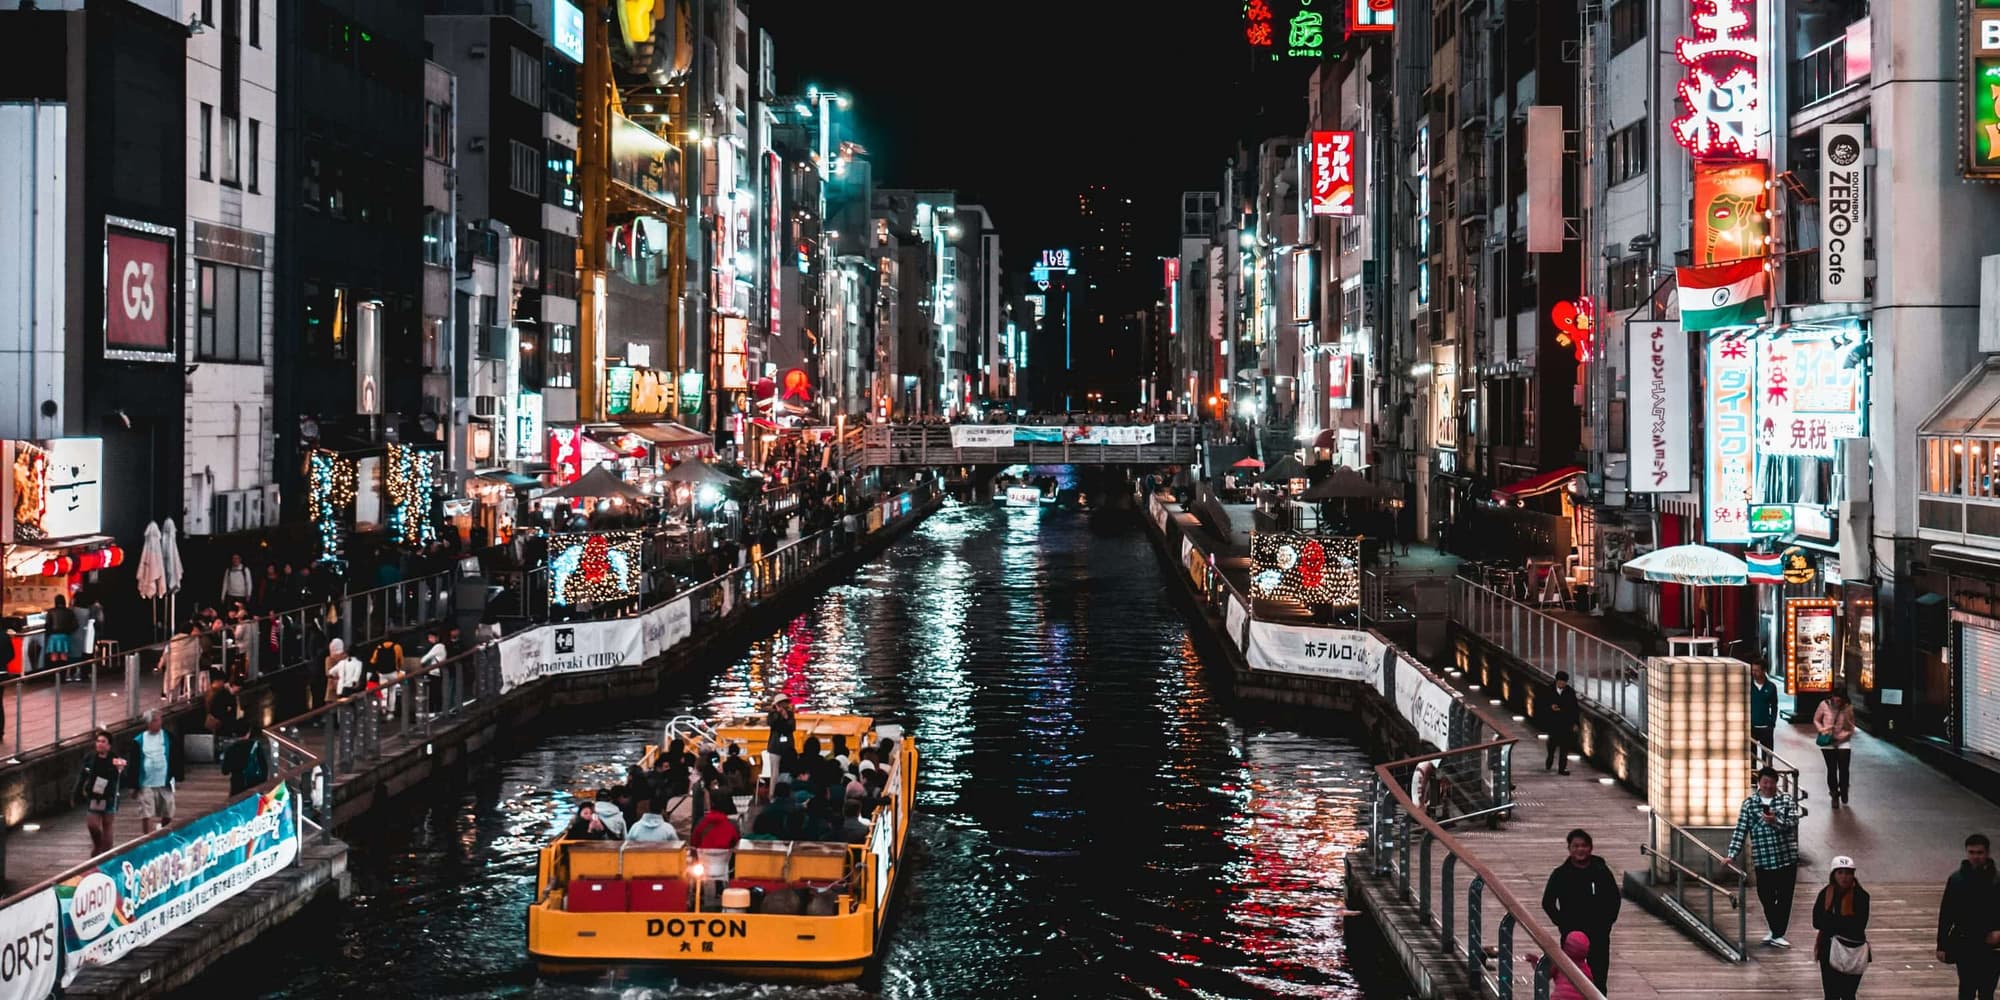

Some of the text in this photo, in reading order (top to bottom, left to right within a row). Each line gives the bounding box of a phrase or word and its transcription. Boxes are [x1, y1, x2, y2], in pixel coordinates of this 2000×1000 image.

[1331, 135, 1350, 182] ツルハ
[122, 260, 154, 321] G3
[1651, 326, 1668, 486] よしもとエンタメショップ
[1790, 418, 1827, 449] 免税
[647, 918, 746, 937] DOTON
